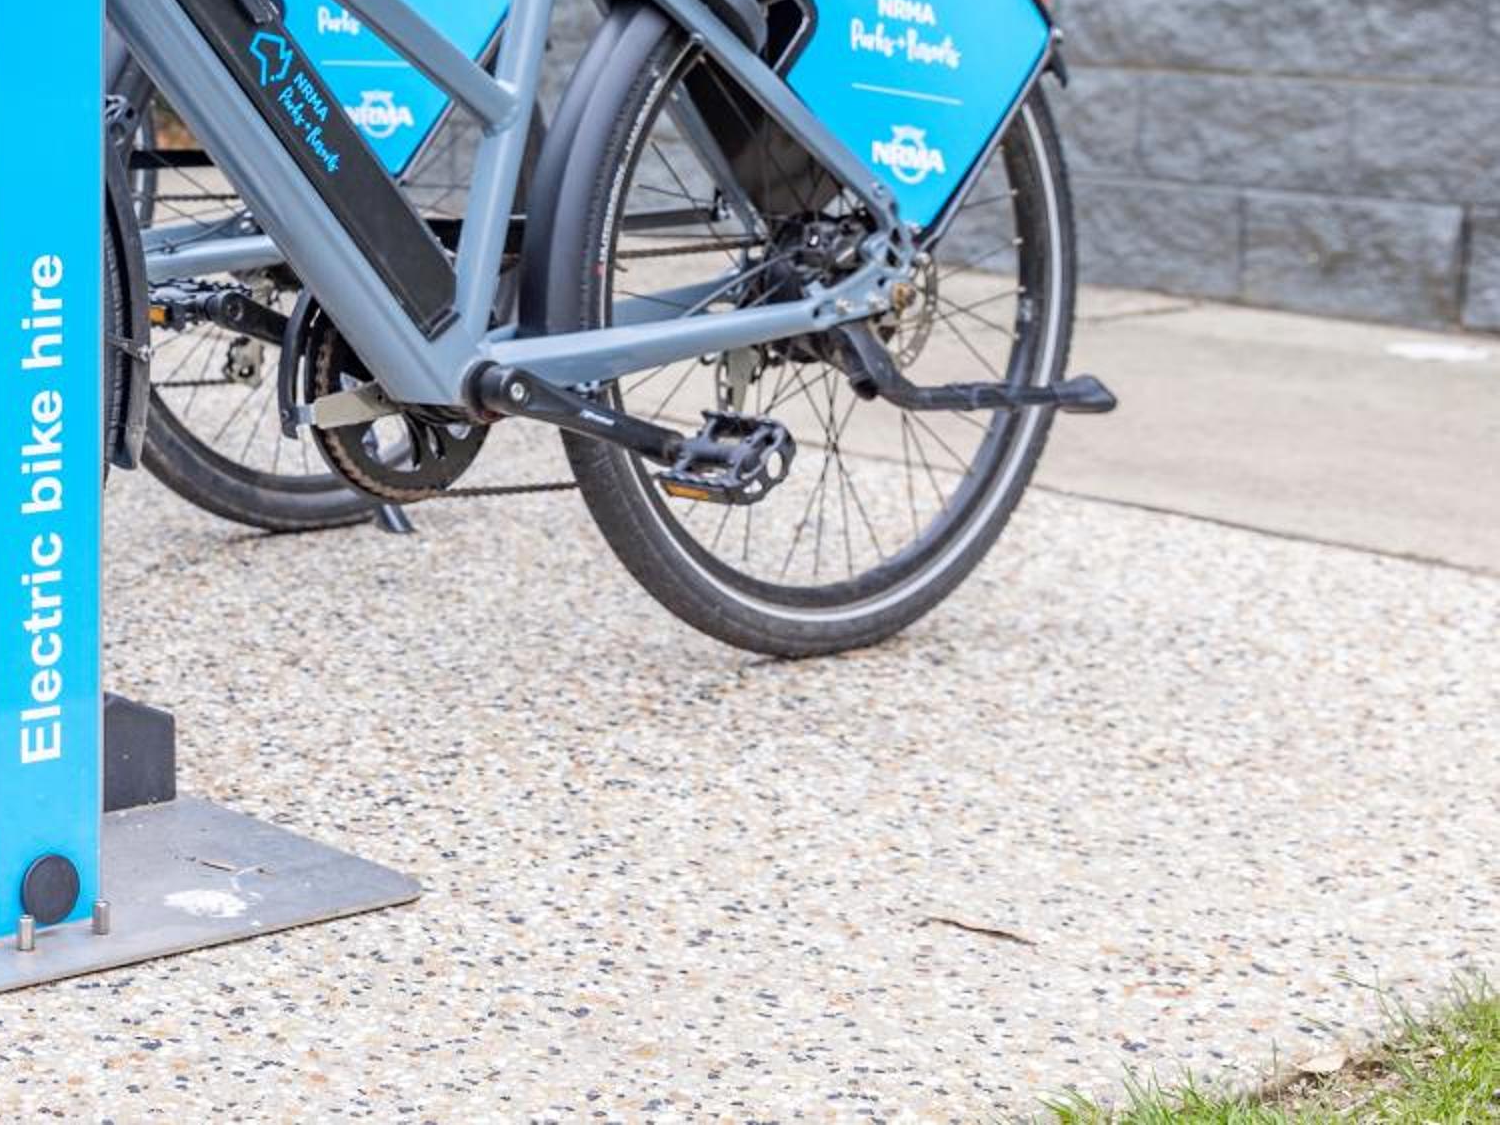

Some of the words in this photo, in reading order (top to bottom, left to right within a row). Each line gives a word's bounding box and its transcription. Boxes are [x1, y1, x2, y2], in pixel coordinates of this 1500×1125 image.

[851, 17, 894, 58] Parks
[277, 85, 304, 126] Parks
[293, 71, 329, 123] NRMA
[871, 140, 946, 174] NRMA
[21, 254, 62, 370] hire
[21, 389, 62, 514] bike
[21, 530, 62, 763] Electric
